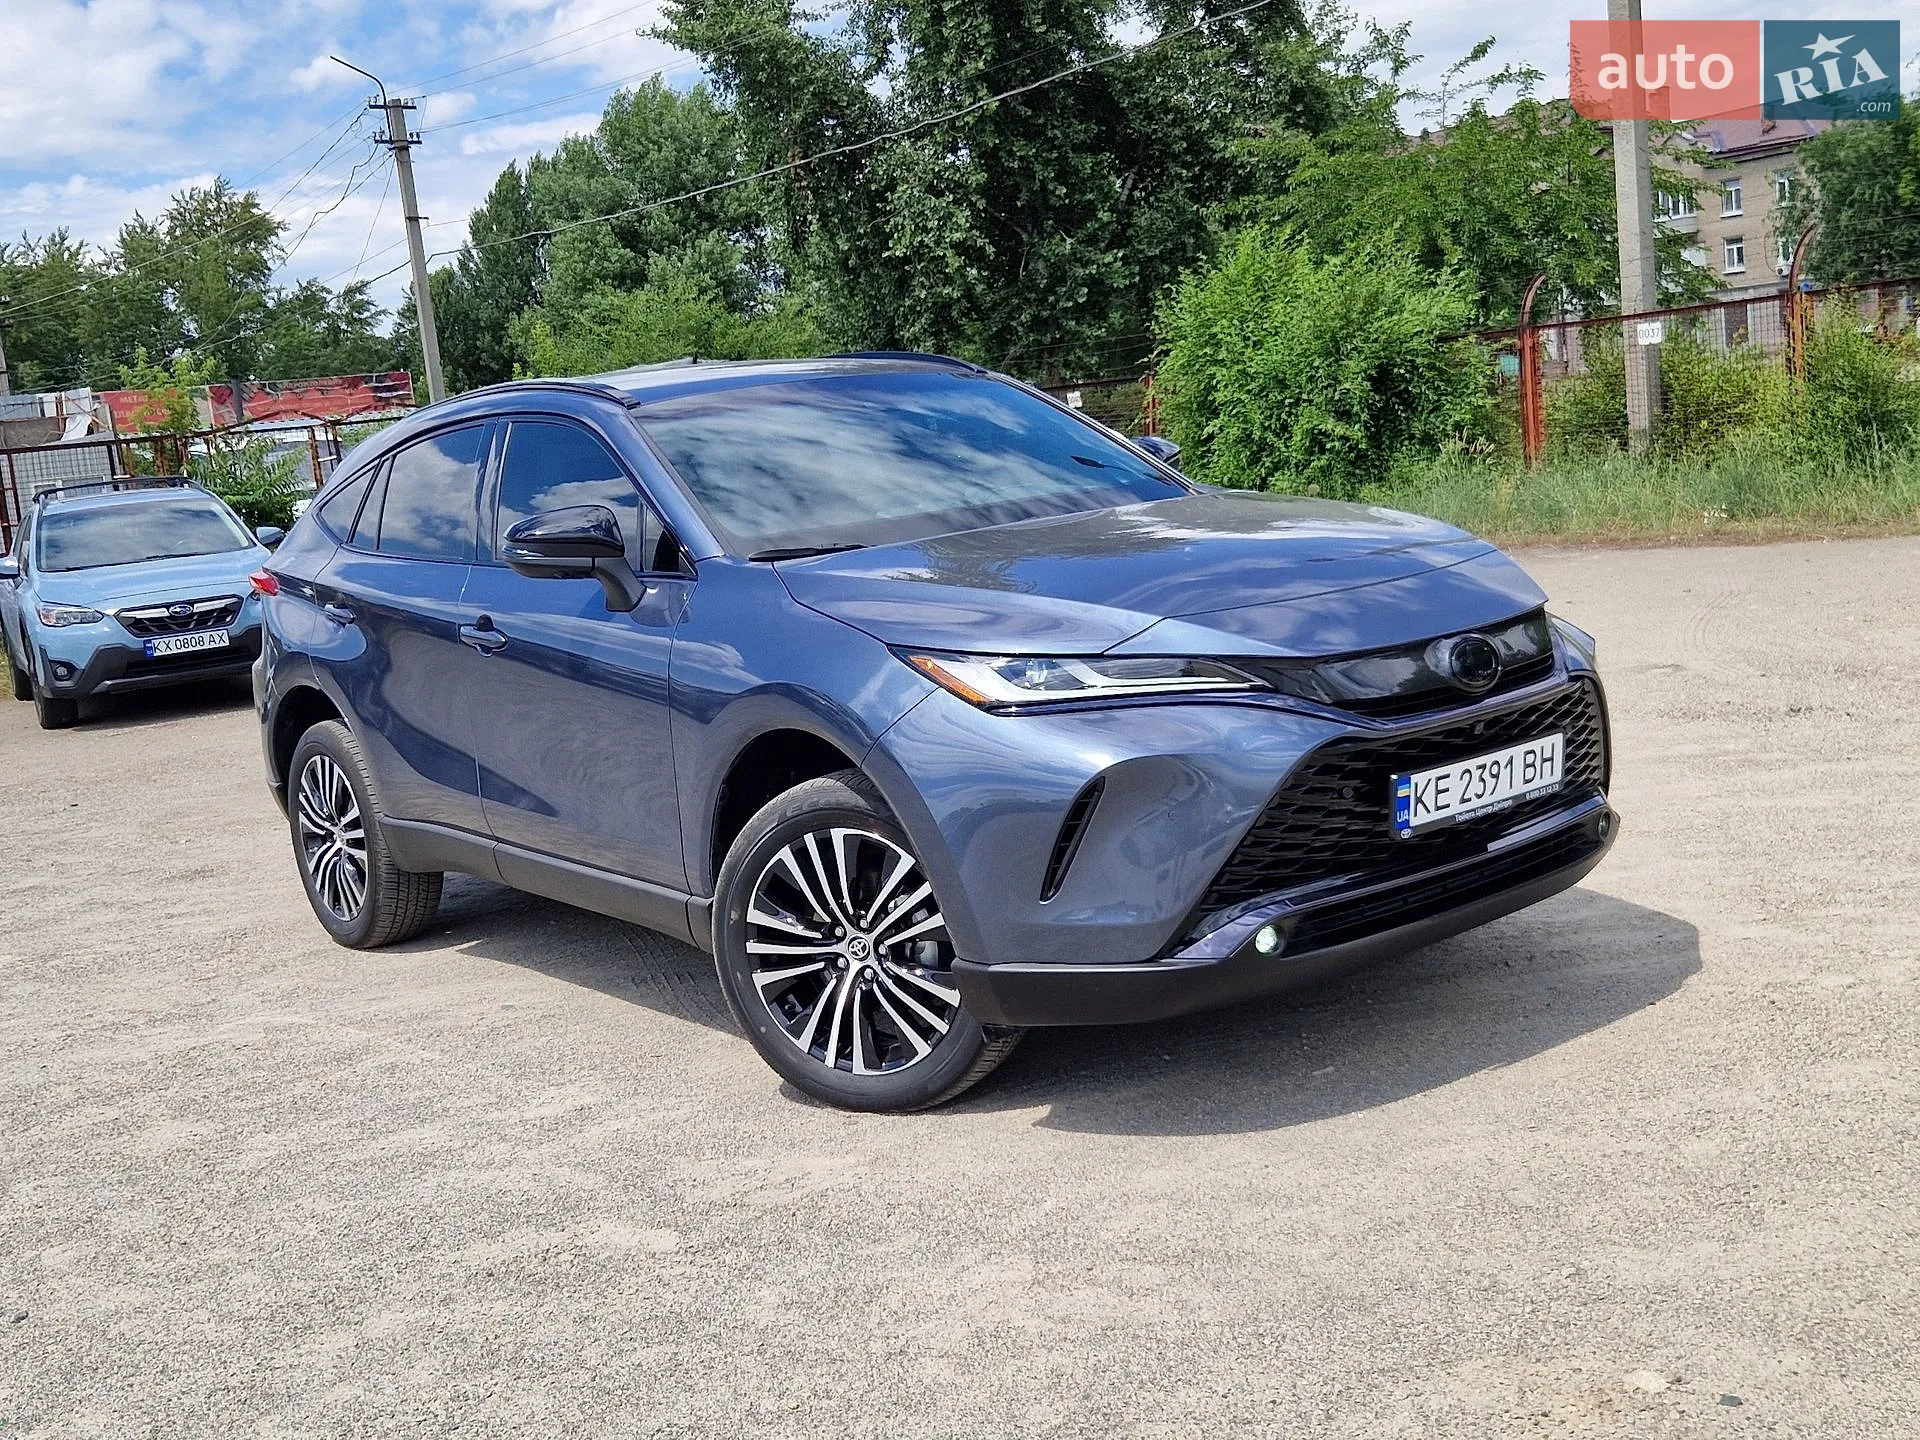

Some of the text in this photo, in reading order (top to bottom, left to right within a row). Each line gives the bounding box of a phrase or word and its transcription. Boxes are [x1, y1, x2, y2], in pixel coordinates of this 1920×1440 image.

[1639, 328, 1660, 339] 0037
[153, 632, 226, 654] KX 0808 AX
[1413, 743, 1555, 817] KE 2391 BH
[1396, 809, 1409, 824] UA
